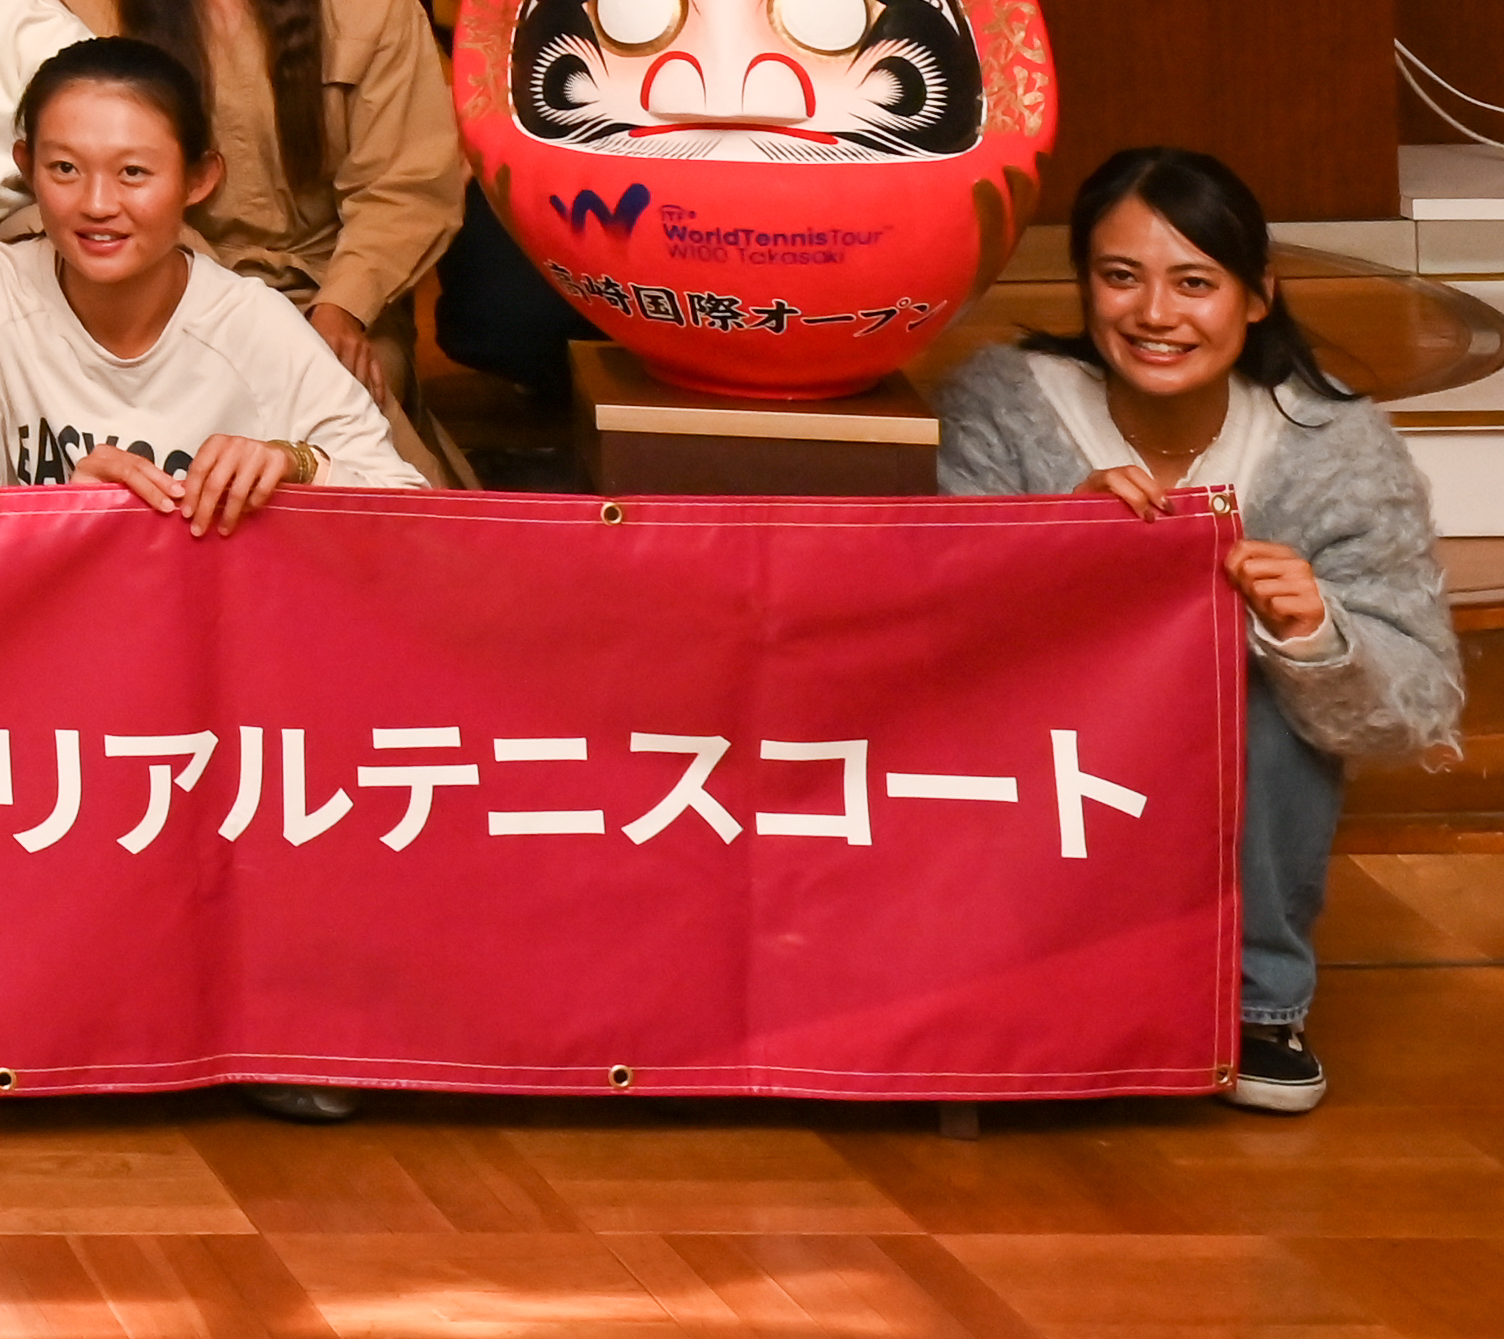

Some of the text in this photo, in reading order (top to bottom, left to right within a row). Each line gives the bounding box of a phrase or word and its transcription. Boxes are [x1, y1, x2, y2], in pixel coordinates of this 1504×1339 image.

[544, 258, 948, 338] 高崎国際オープン
